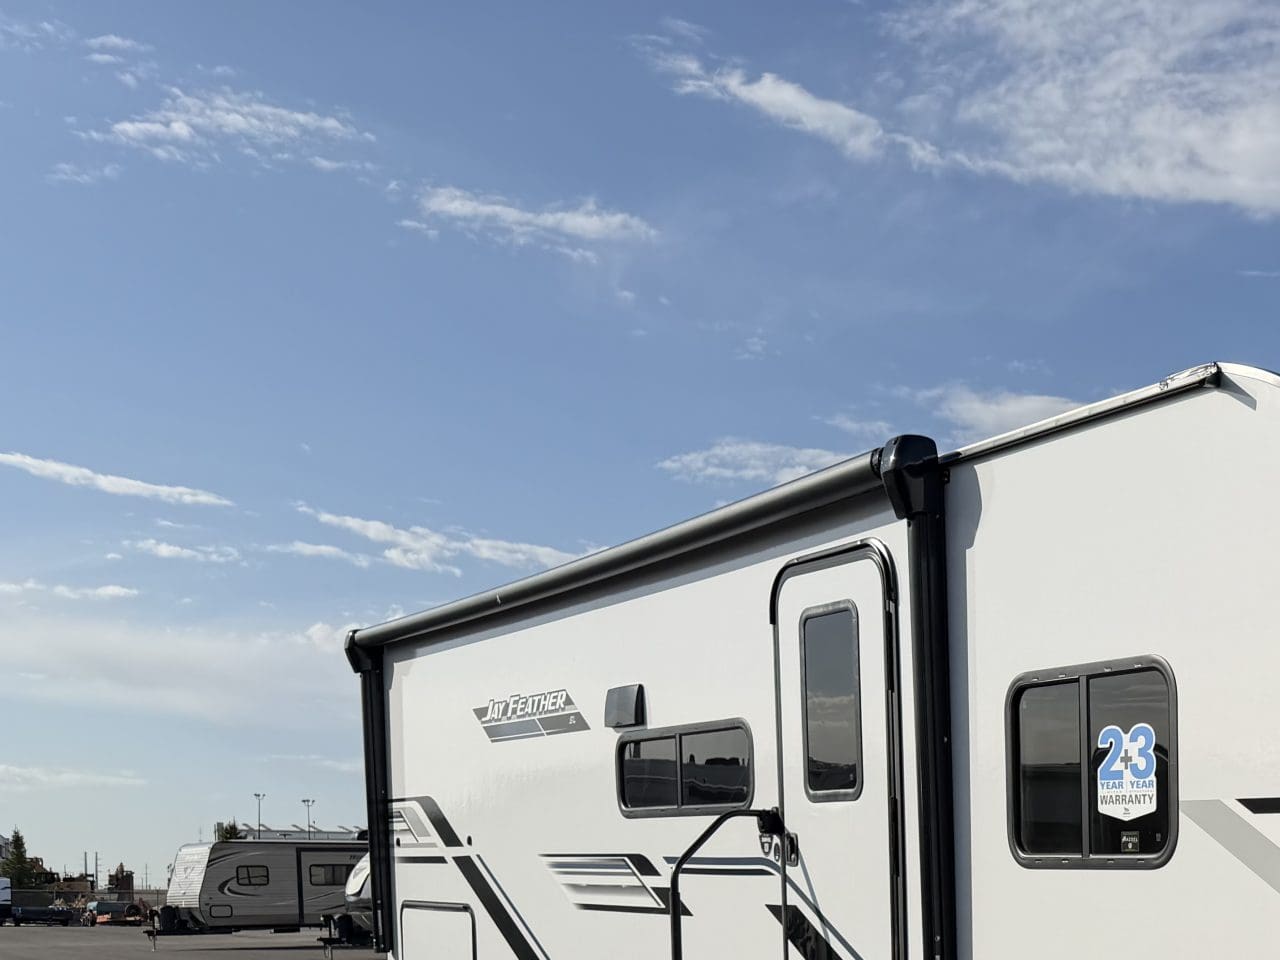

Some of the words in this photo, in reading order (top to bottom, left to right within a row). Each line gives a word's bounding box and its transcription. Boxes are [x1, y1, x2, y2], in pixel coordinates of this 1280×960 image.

[480, 699, 508, 722] JAY
[507, 690, 567, 718] FEATHER
[1100, 780, 1124, 789] YEAR
[1130, 779, 1154, 789] YEAR
[1099, 793, 1154, 806] WARRANTY
